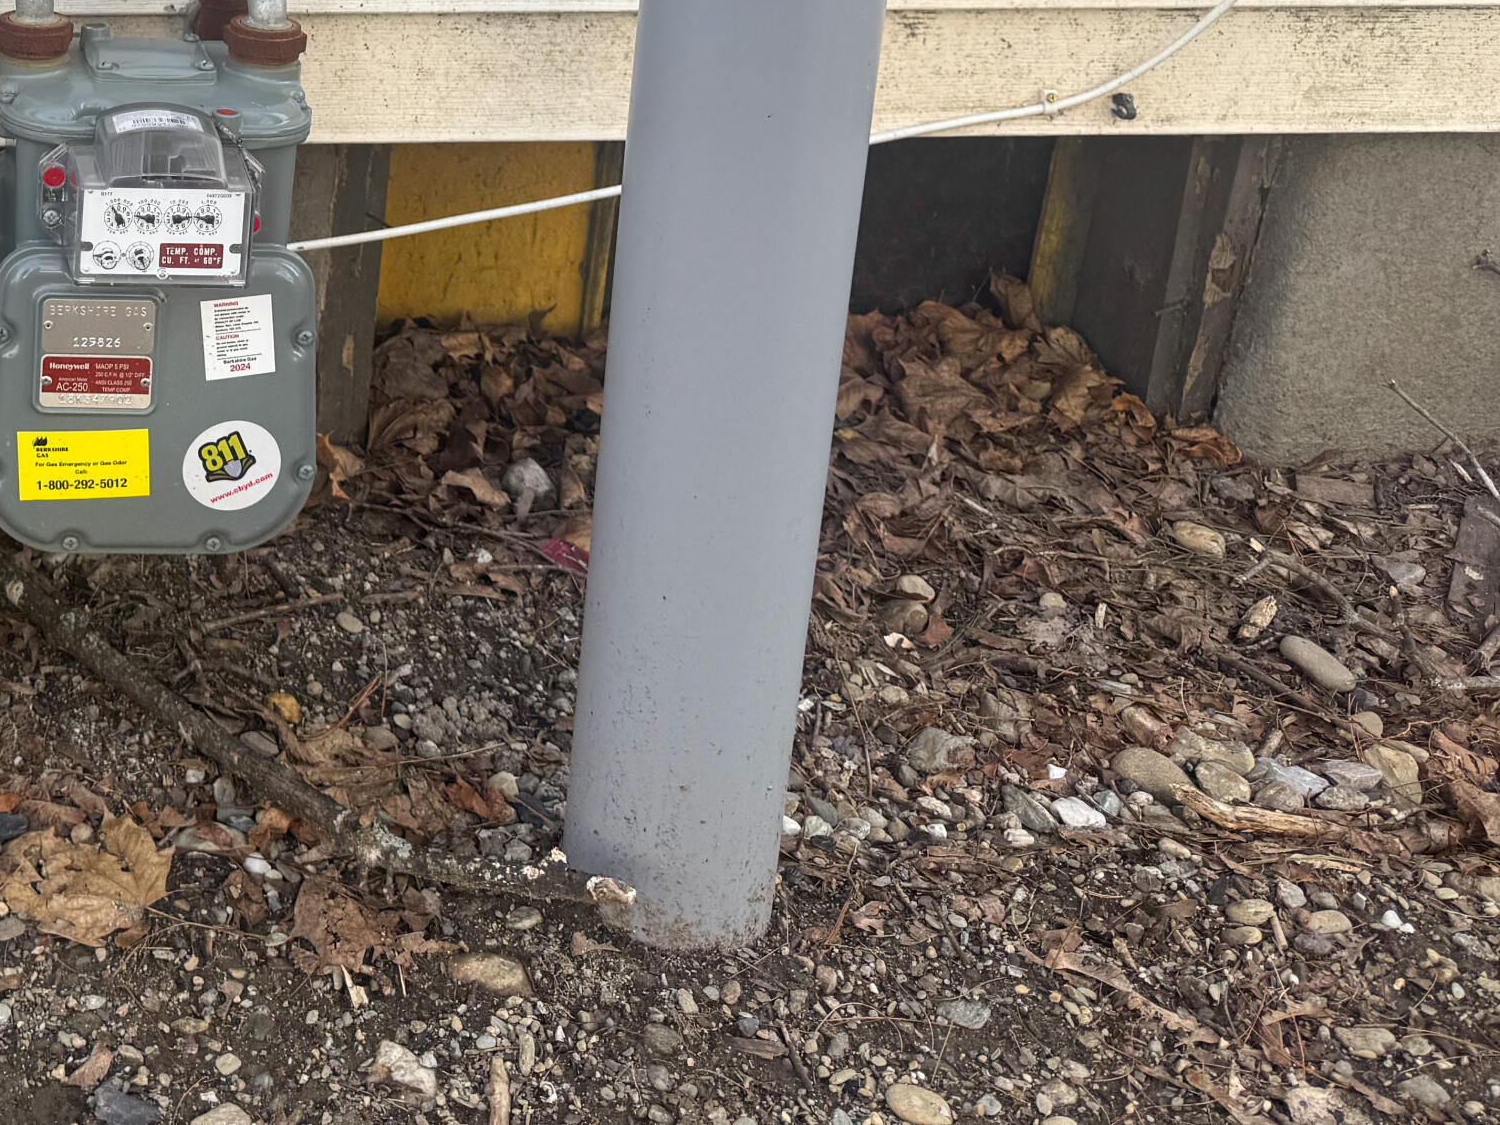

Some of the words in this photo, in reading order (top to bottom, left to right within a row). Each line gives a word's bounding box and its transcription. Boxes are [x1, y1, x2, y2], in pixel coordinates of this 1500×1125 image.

[166, 247, 189, 256] TEMP.
[193, 246, 218, 257] COMP.
[161, 256, 175, 265] CU.
[179, 256, 191, 265] FT.
[49, 362, 90, 371] Honeywell
[229, 363, 251, 372] 2024
[56, 381, 88, 392] AC-250
[201, 434, 246, 472] 811
[36, 478, 128, 491] 1-800-292-5012
